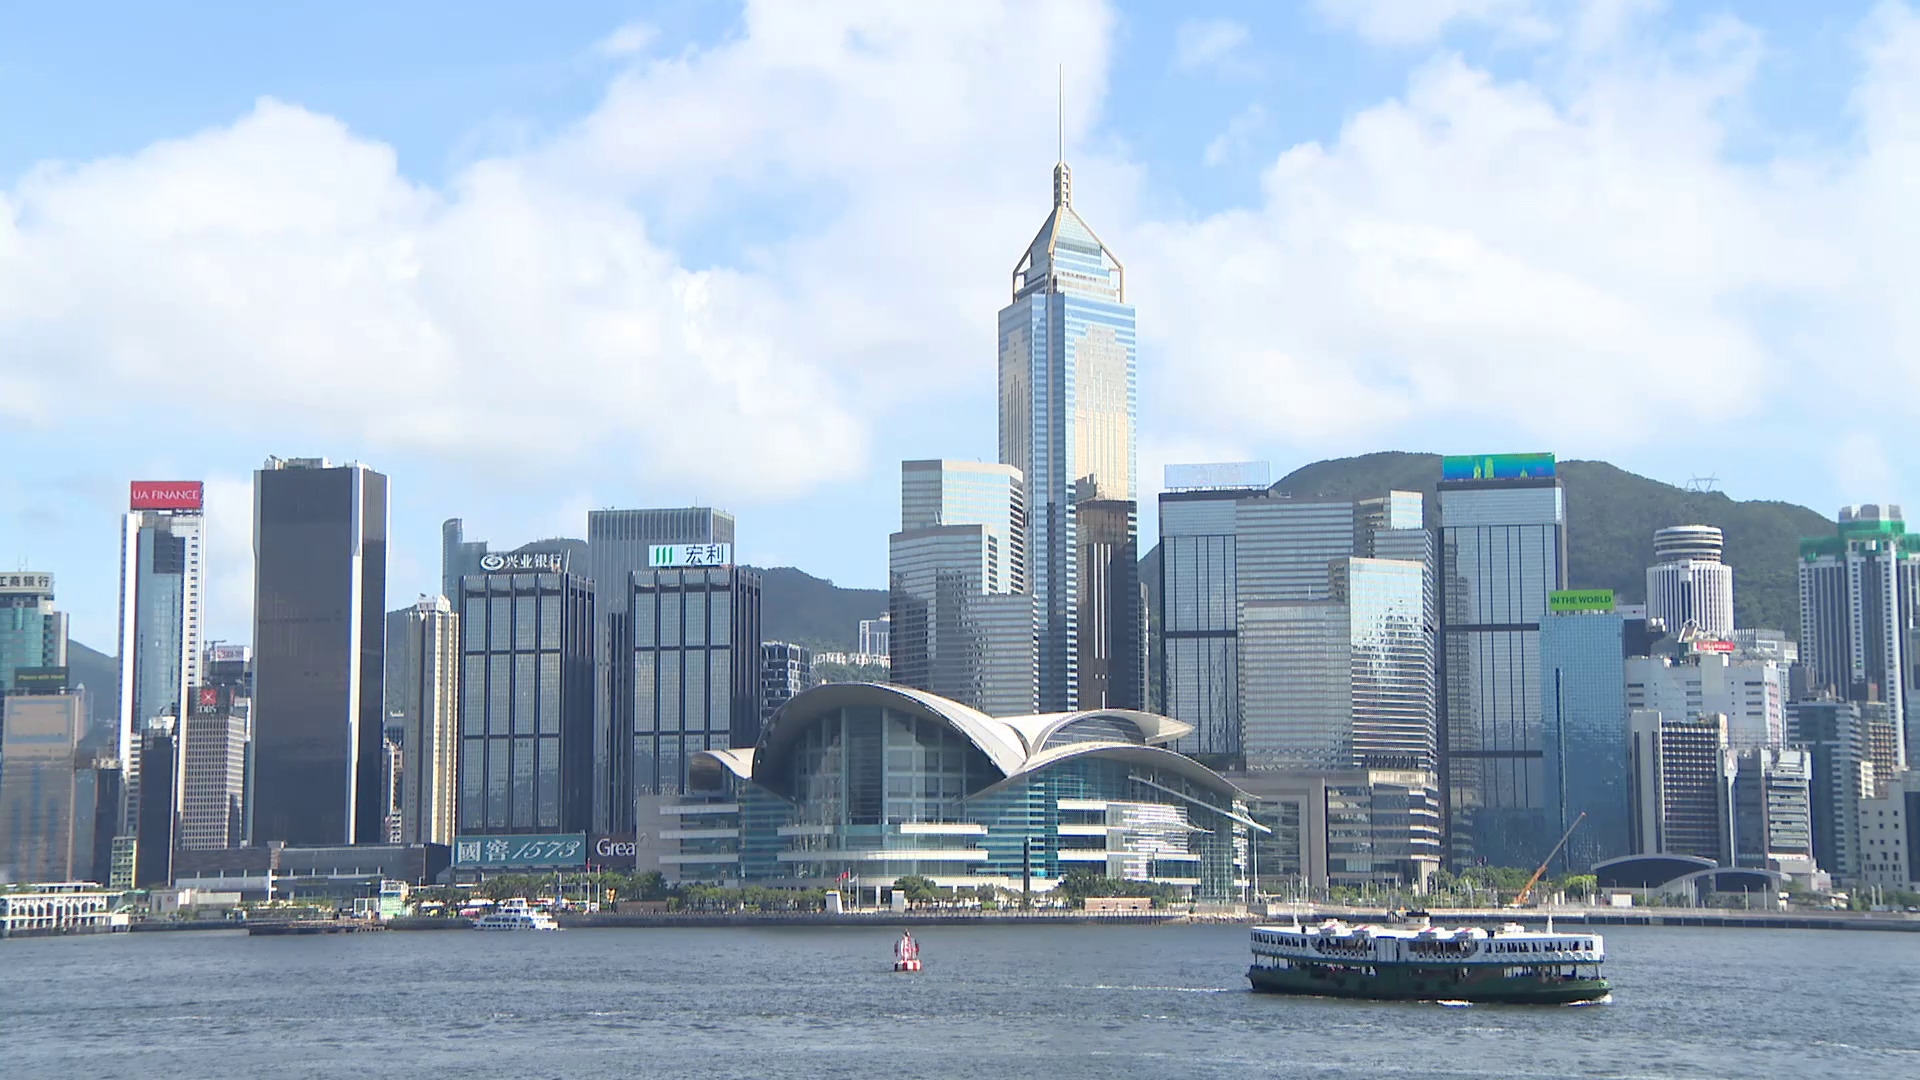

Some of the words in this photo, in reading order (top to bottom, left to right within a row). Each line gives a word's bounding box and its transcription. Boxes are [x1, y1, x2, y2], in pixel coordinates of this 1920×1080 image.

[133, 490, 149, 500] UA
[151, 490, 198, 500] FINANCE
[505, 553, 562, 569] 兴业银行
[685, 544, 724, 564] 宏利
[1578, 596, 1611, 604] WORLD
[596, 838, 637, 857] Grea
